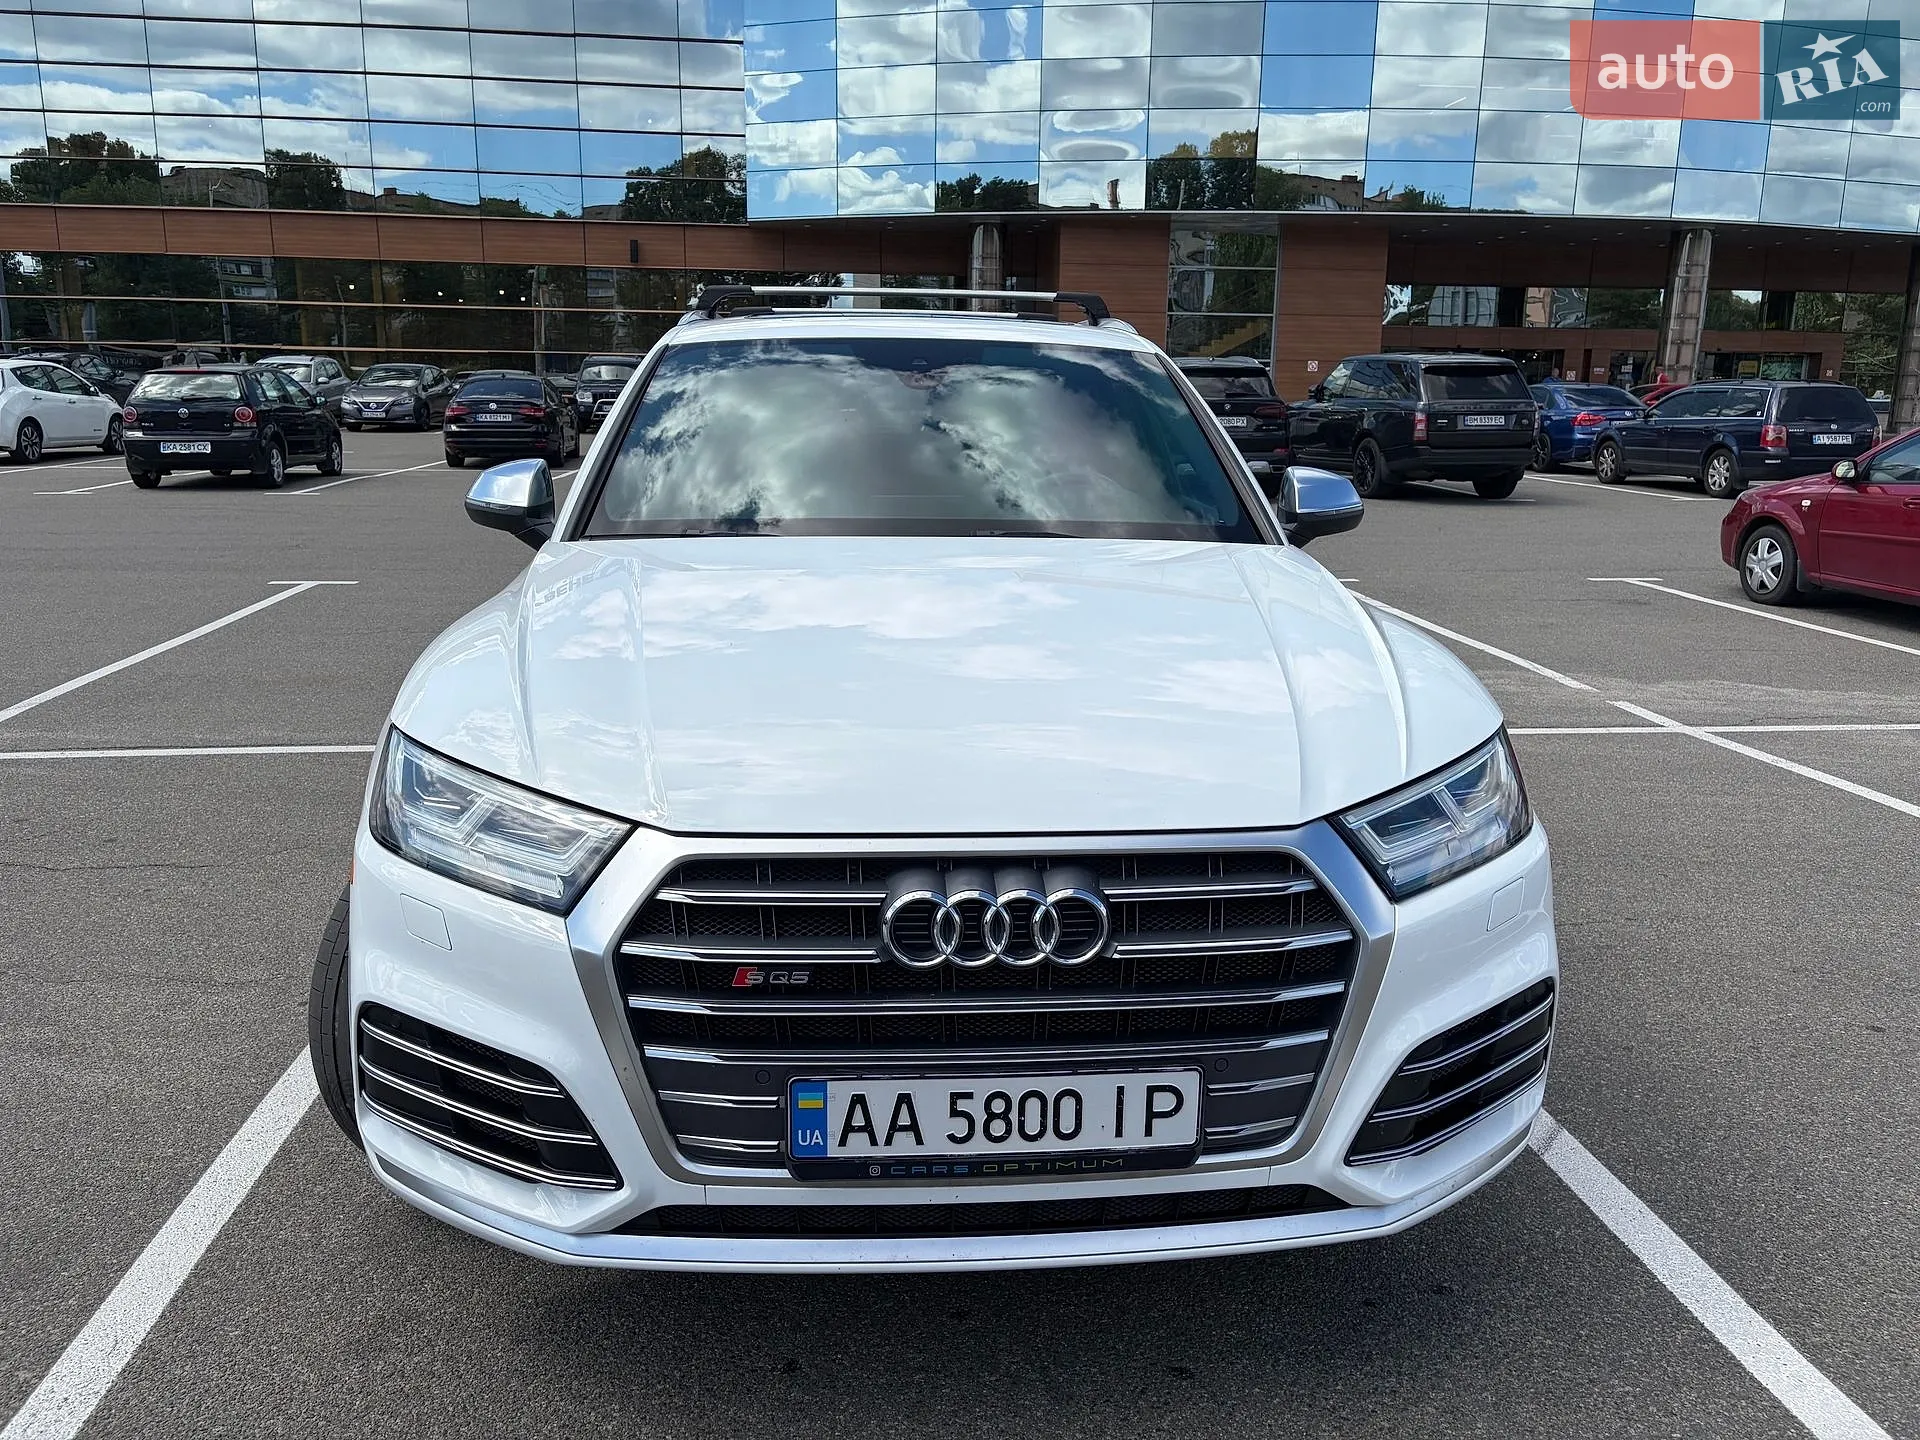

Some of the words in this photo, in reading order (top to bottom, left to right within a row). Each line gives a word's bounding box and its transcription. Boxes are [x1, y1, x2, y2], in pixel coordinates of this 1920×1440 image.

[166, 442, 178, 451] KA
[837, 1091, 925, 1148] AA
[945, 1087, 1083, 1145] 5800
[1114, 1083, 1185, 1139] IP
[798, 1129, 824, 1146] UA
